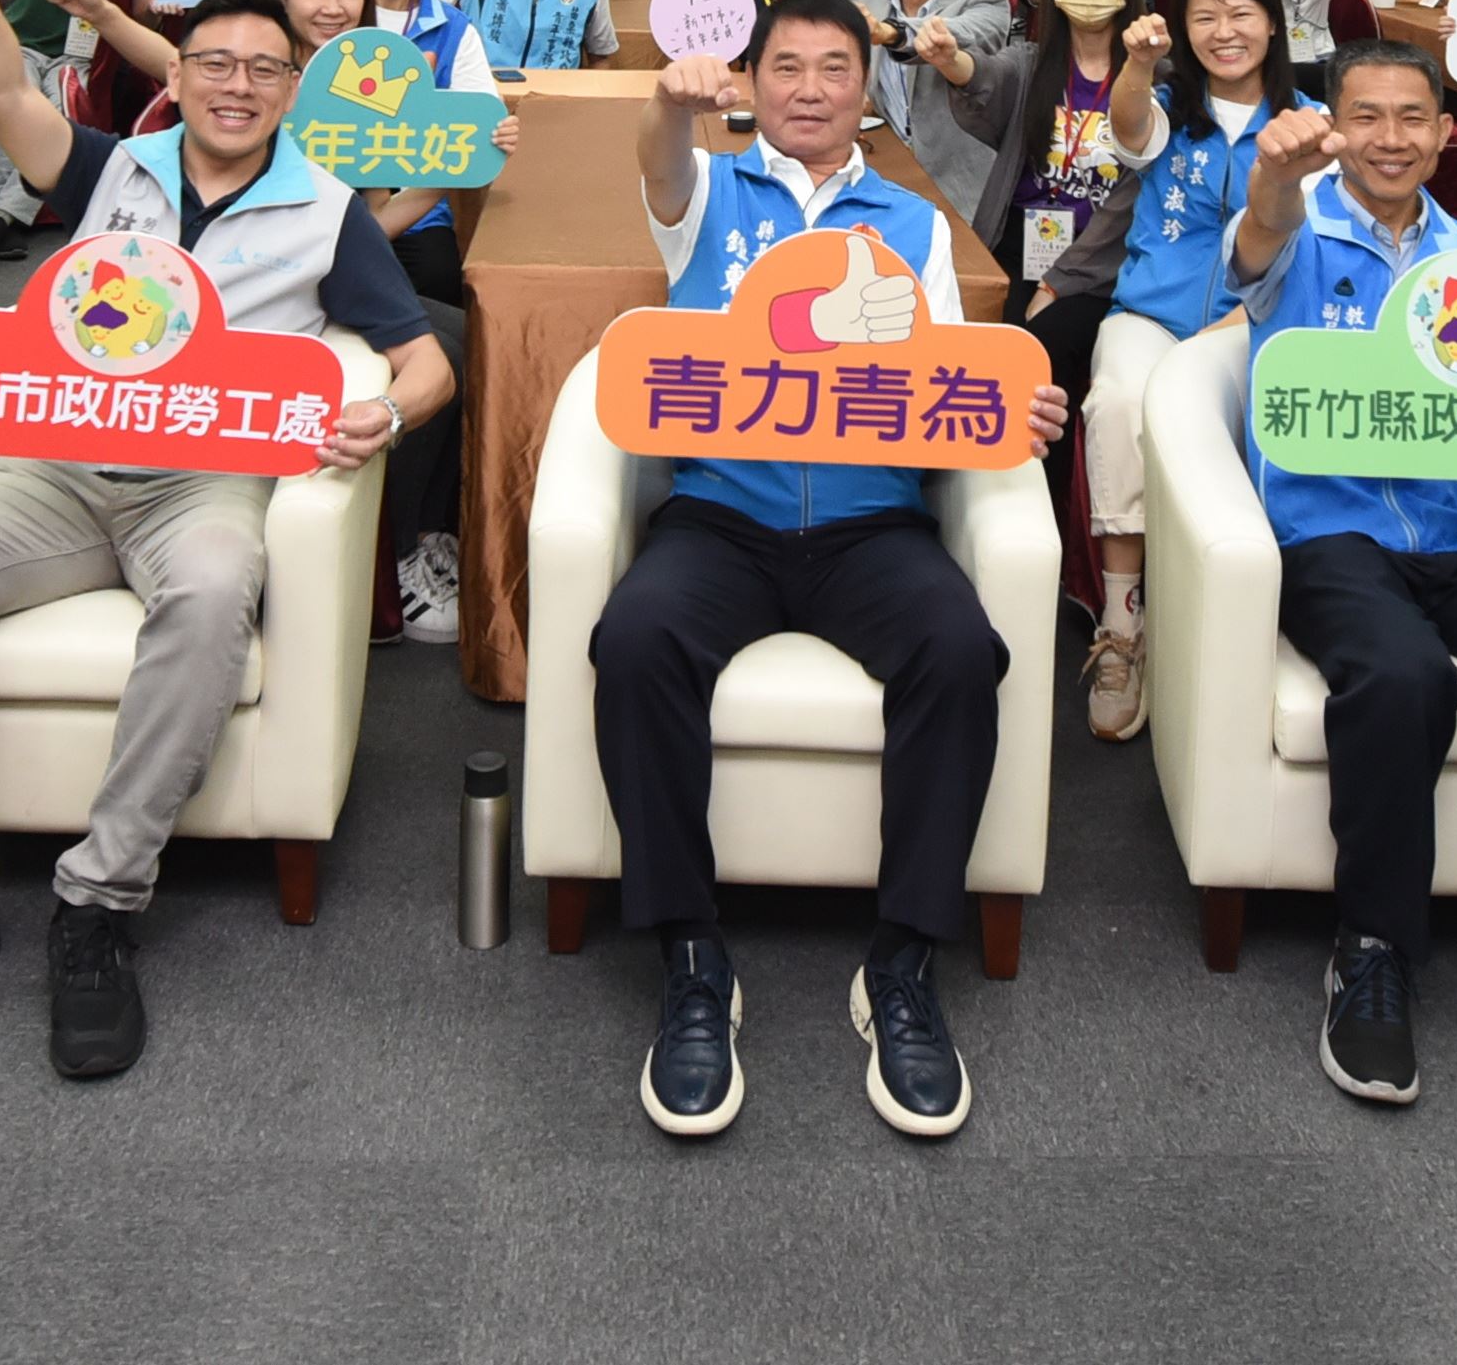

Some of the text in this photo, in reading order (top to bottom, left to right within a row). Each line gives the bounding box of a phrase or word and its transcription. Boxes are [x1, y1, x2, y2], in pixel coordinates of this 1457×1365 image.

[285, 119, 478, 176] 年共好
[643, 354, 1007, 446] 青力青為
